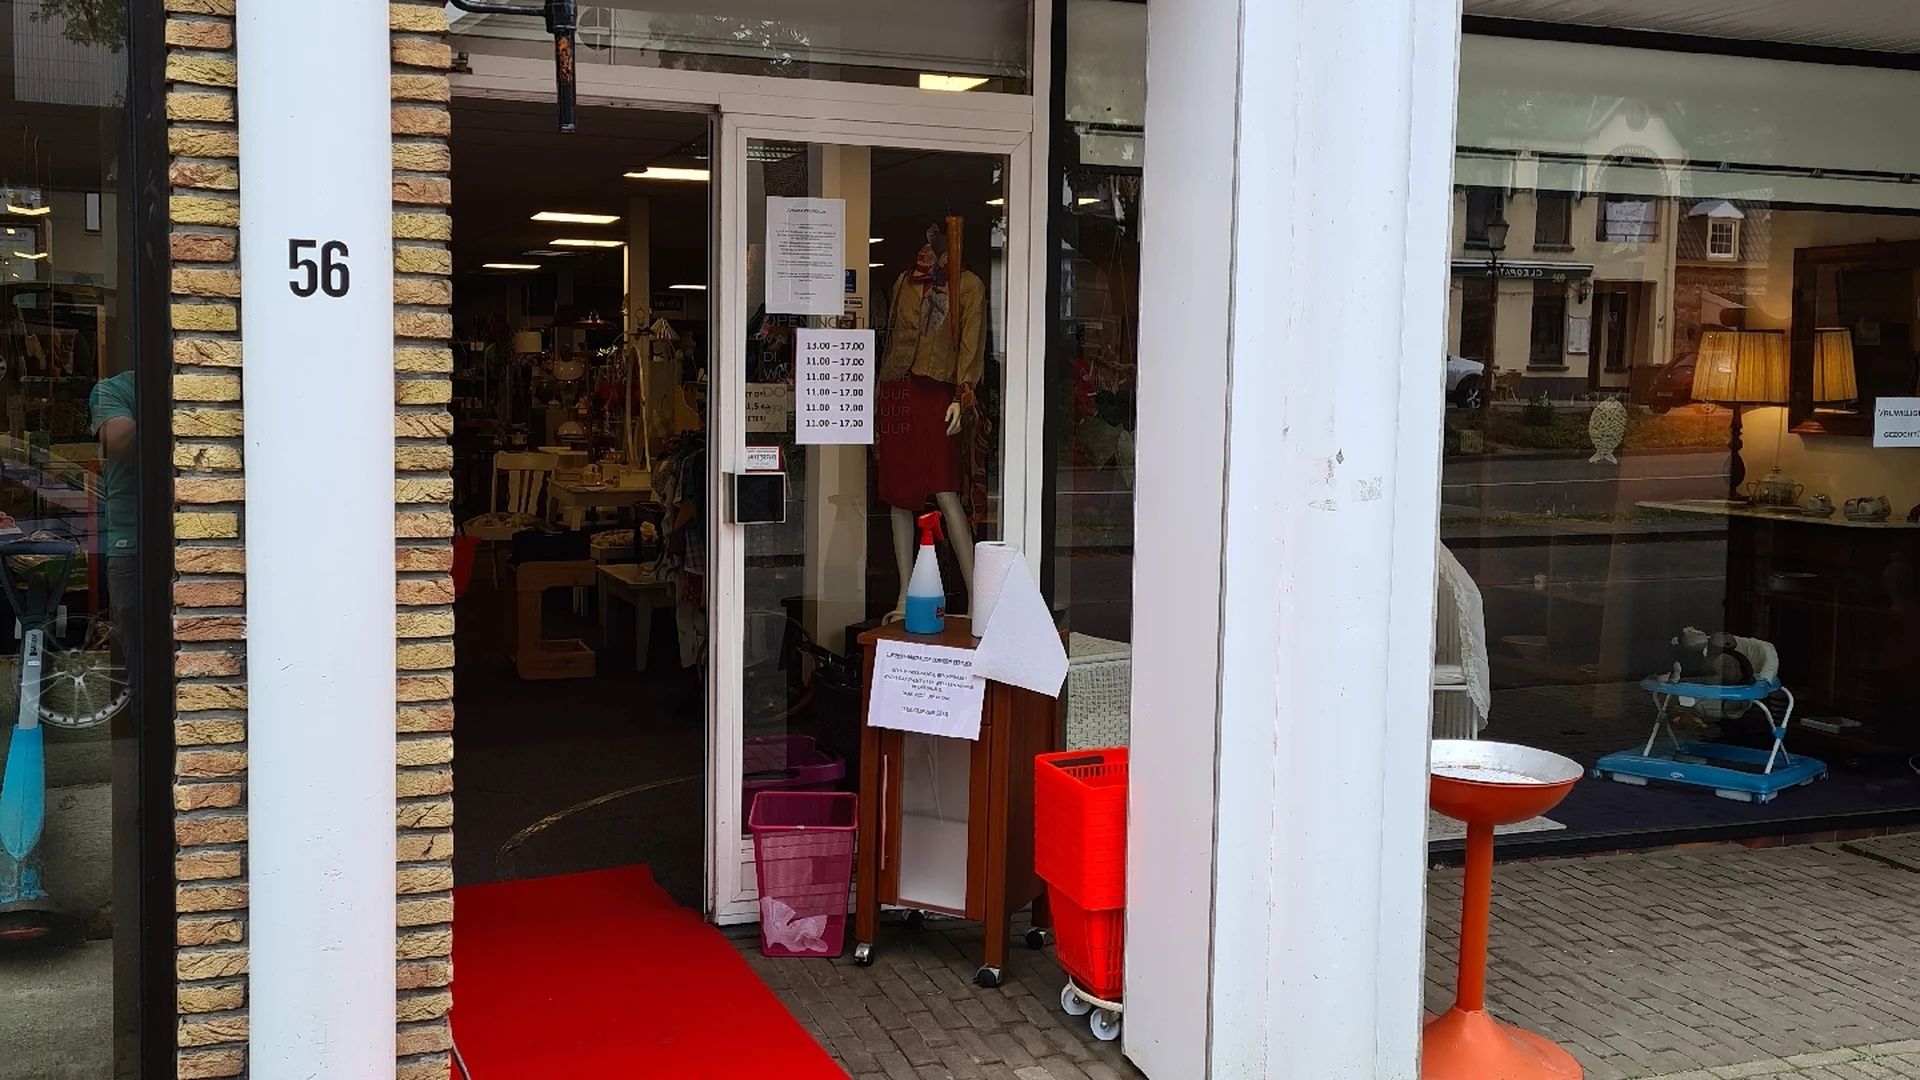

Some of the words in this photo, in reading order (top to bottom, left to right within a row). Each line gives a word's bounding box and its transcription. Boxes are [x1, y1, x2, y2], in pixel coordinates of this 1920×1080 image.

[288, 239, 351, 299] 56
[840, 341, 865, 351] 17.00
[806, 357, 831, 366] 11.00
[840, 357, 865, 366] 17.00
[806, 373, 830, 381] 11.00
[840, 373, 864, 382] 17.00
[806, 388, 830, 397] 11.00
[840, 389, 864, 397] 17.00
[806, 404, 830, 412] 11.00
[840, 404, 864, 412] 17.00
[806, 419, 830, 428] 11.00
[840, 419, 864, 428] 17.00
